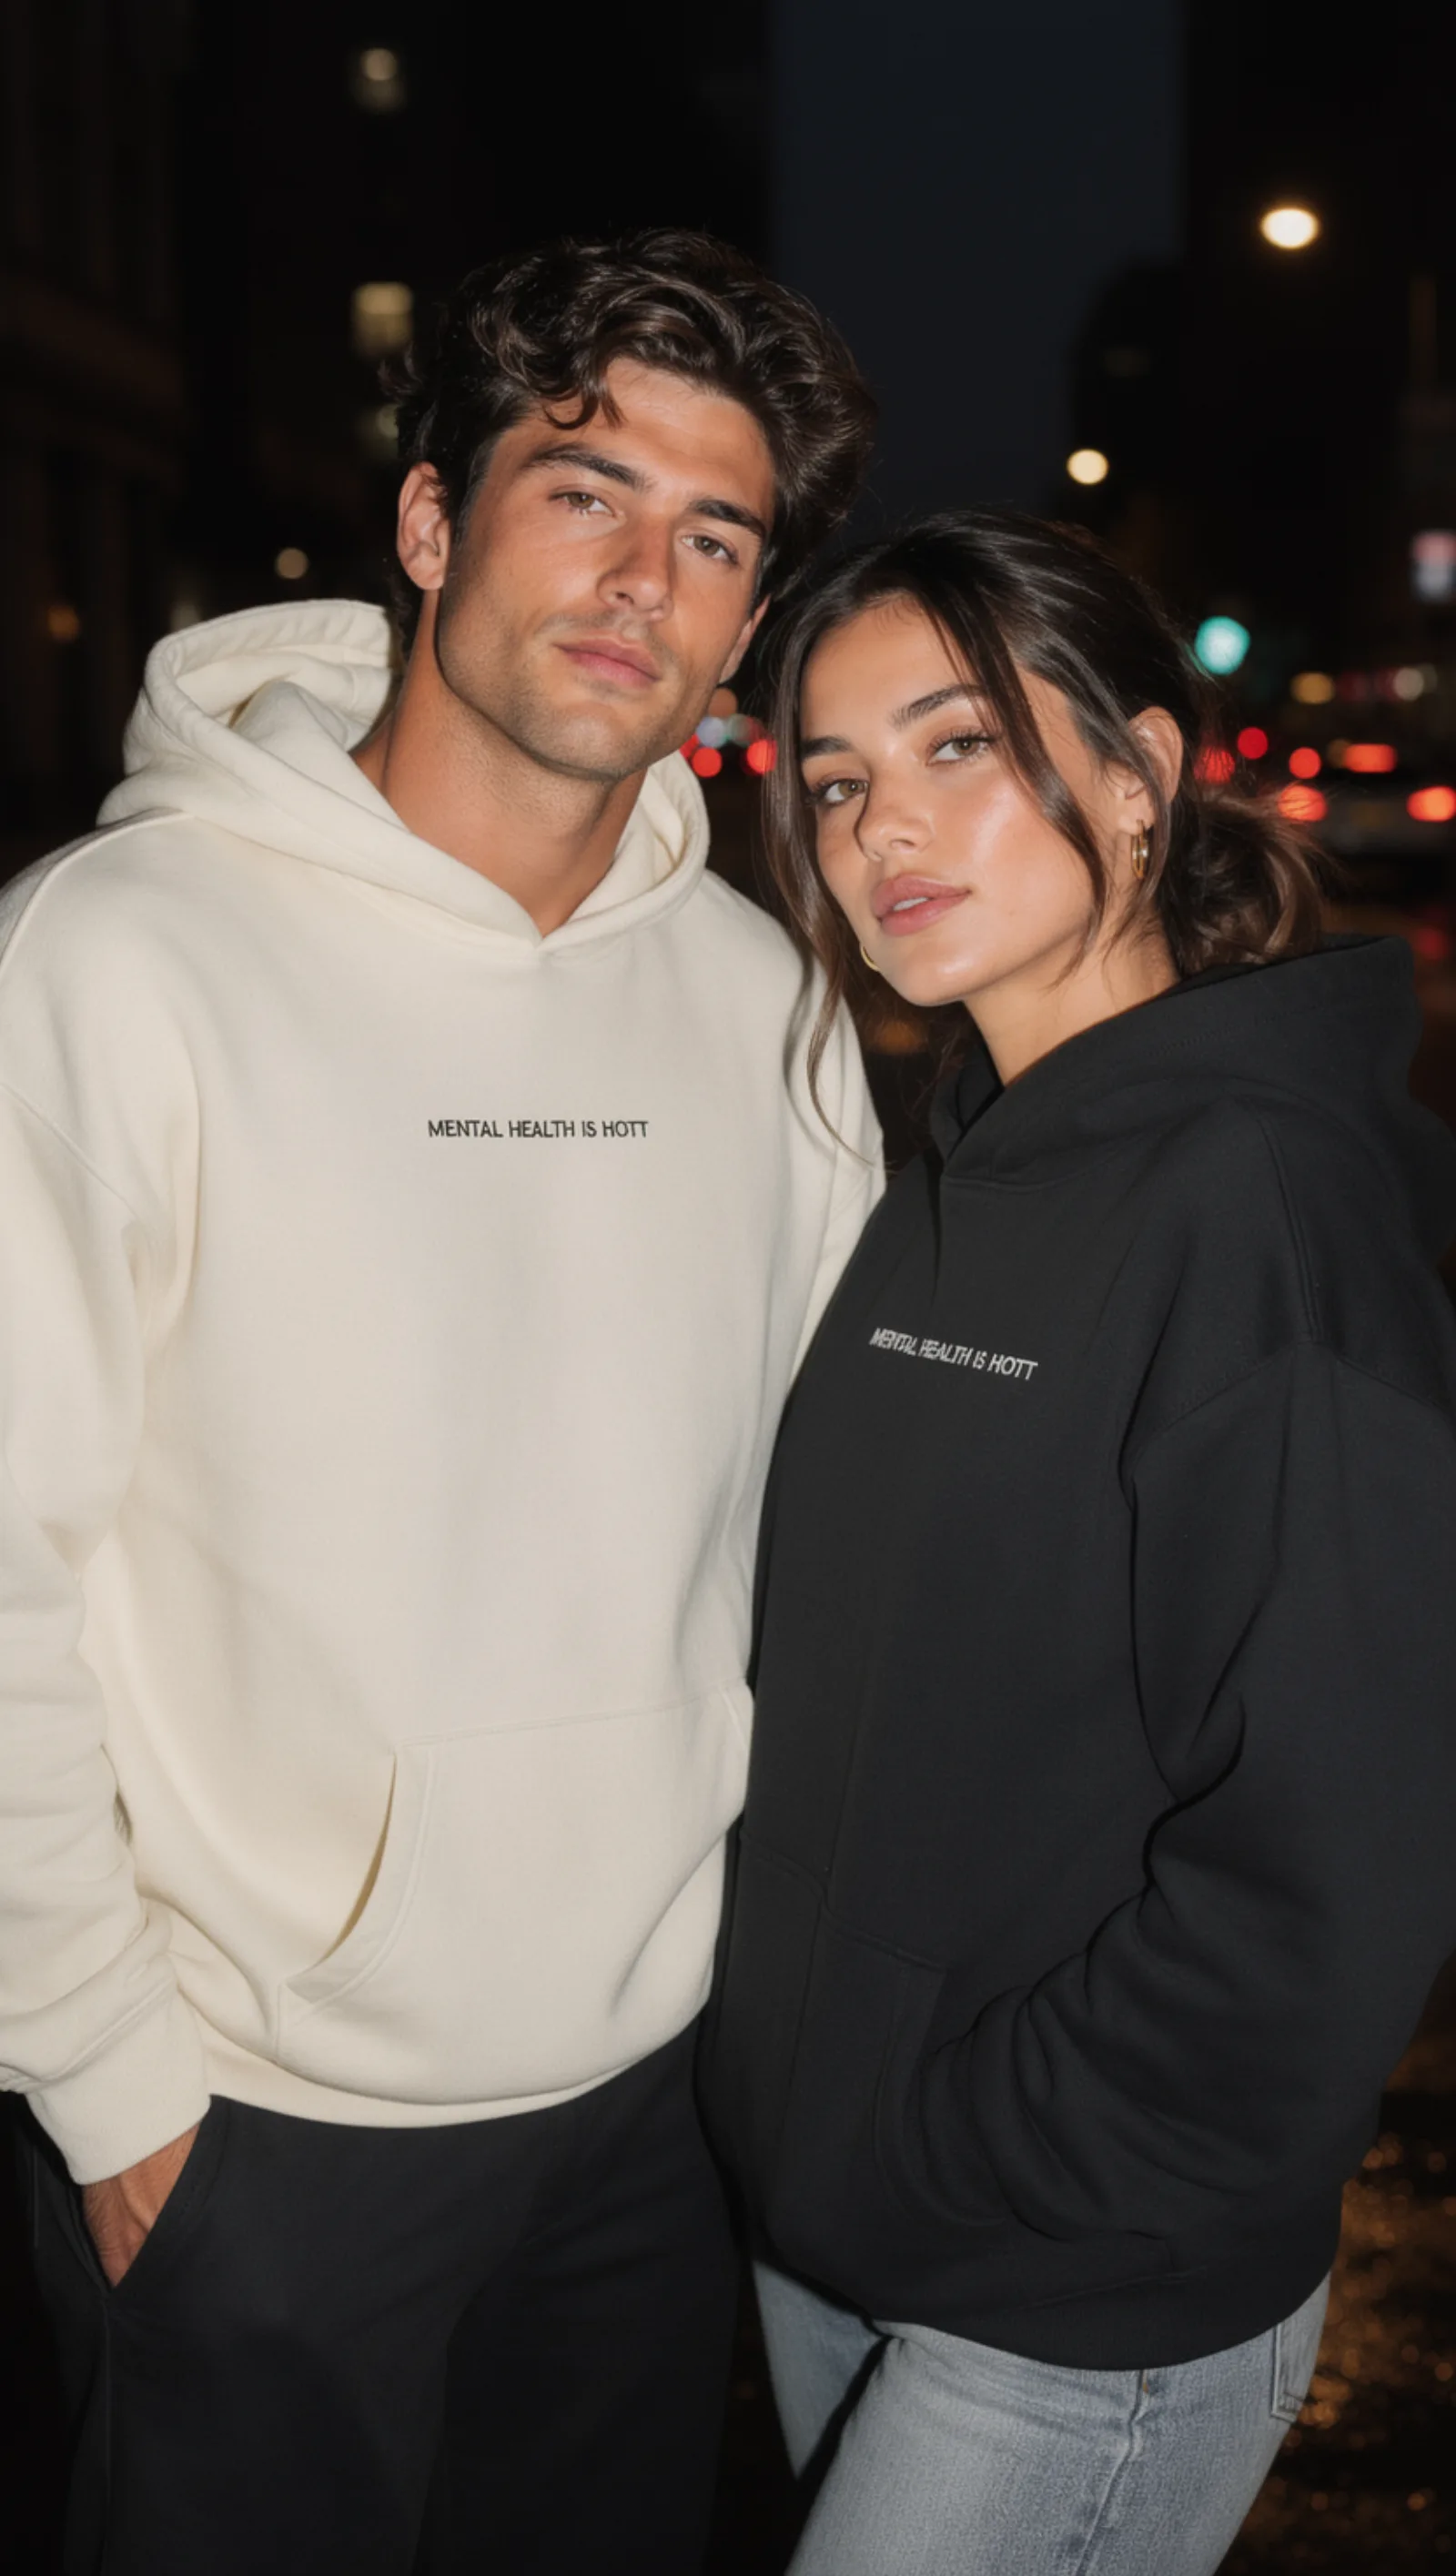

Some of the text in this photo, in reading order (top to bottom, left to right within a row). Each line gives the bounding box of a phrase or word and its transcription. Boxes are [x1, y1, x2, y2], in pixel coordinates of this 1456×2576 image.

[428, 1120, 649, 1137] MENTAL HEALTH IS HOTT
[974, 1350, 987, 1369] IS
[987, 1353, 1038, 1380] HOTT
